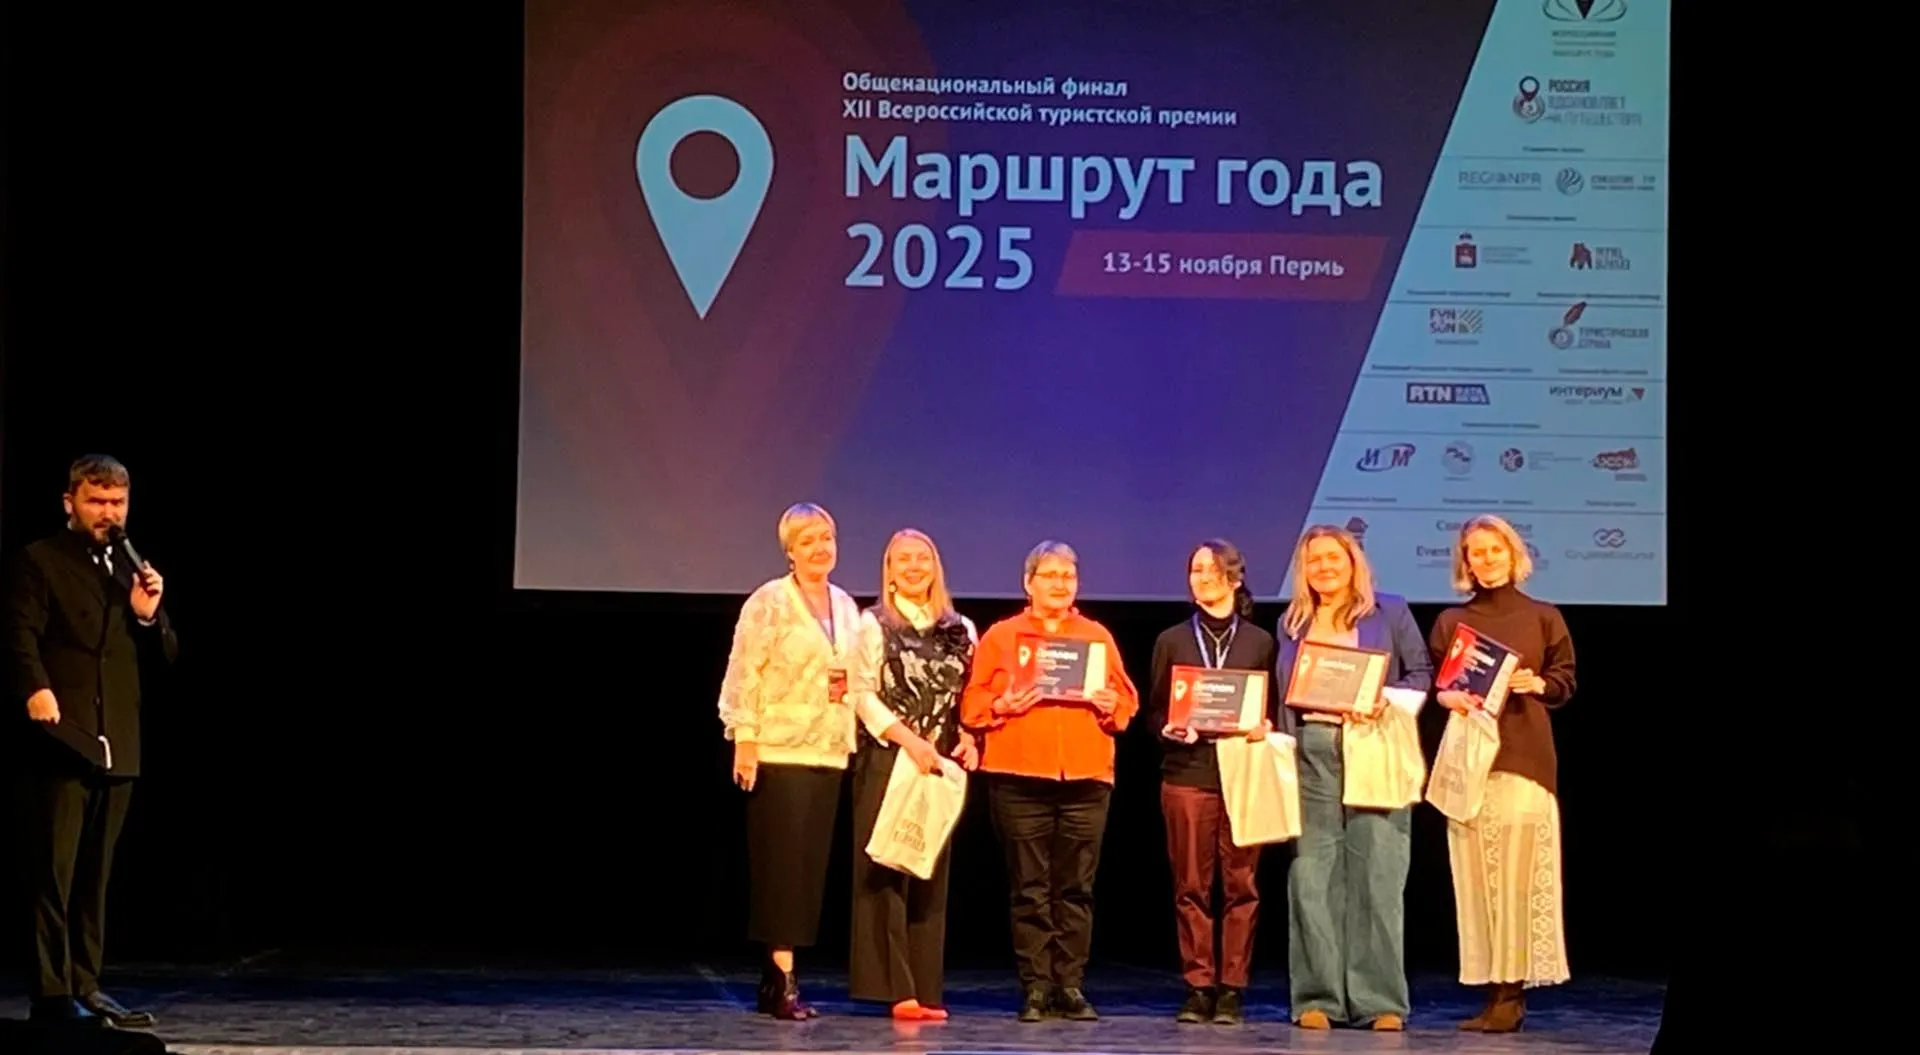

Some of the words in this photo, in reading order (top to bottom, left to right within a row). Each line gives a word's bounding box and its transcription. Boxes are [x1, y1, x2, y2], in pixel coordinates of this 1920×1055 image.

[843, 72, 1055, 95] Общенациональный
[1061, 77, 1127, 99] финал
[843, 99, 871, 118] XII
[878, 99, 1033, 123] Всероссийской
[1038, 105, 1152, 126] туристской
[1158, 110, 1237, 128] премии
[845, 134, 1195, 219] Маршрут
[1217, 159, 1382, 216] года
[845, 223, 1033, 290] 2025
[1104, 252, 1171, 273] 13-15
[1180, 254, 1262, 279] ноября
[1270, 255, 1344, 281] Пермь
[1409, 385, 1451, 402] RTN
[1550, 385, 1623, 399] интериум
